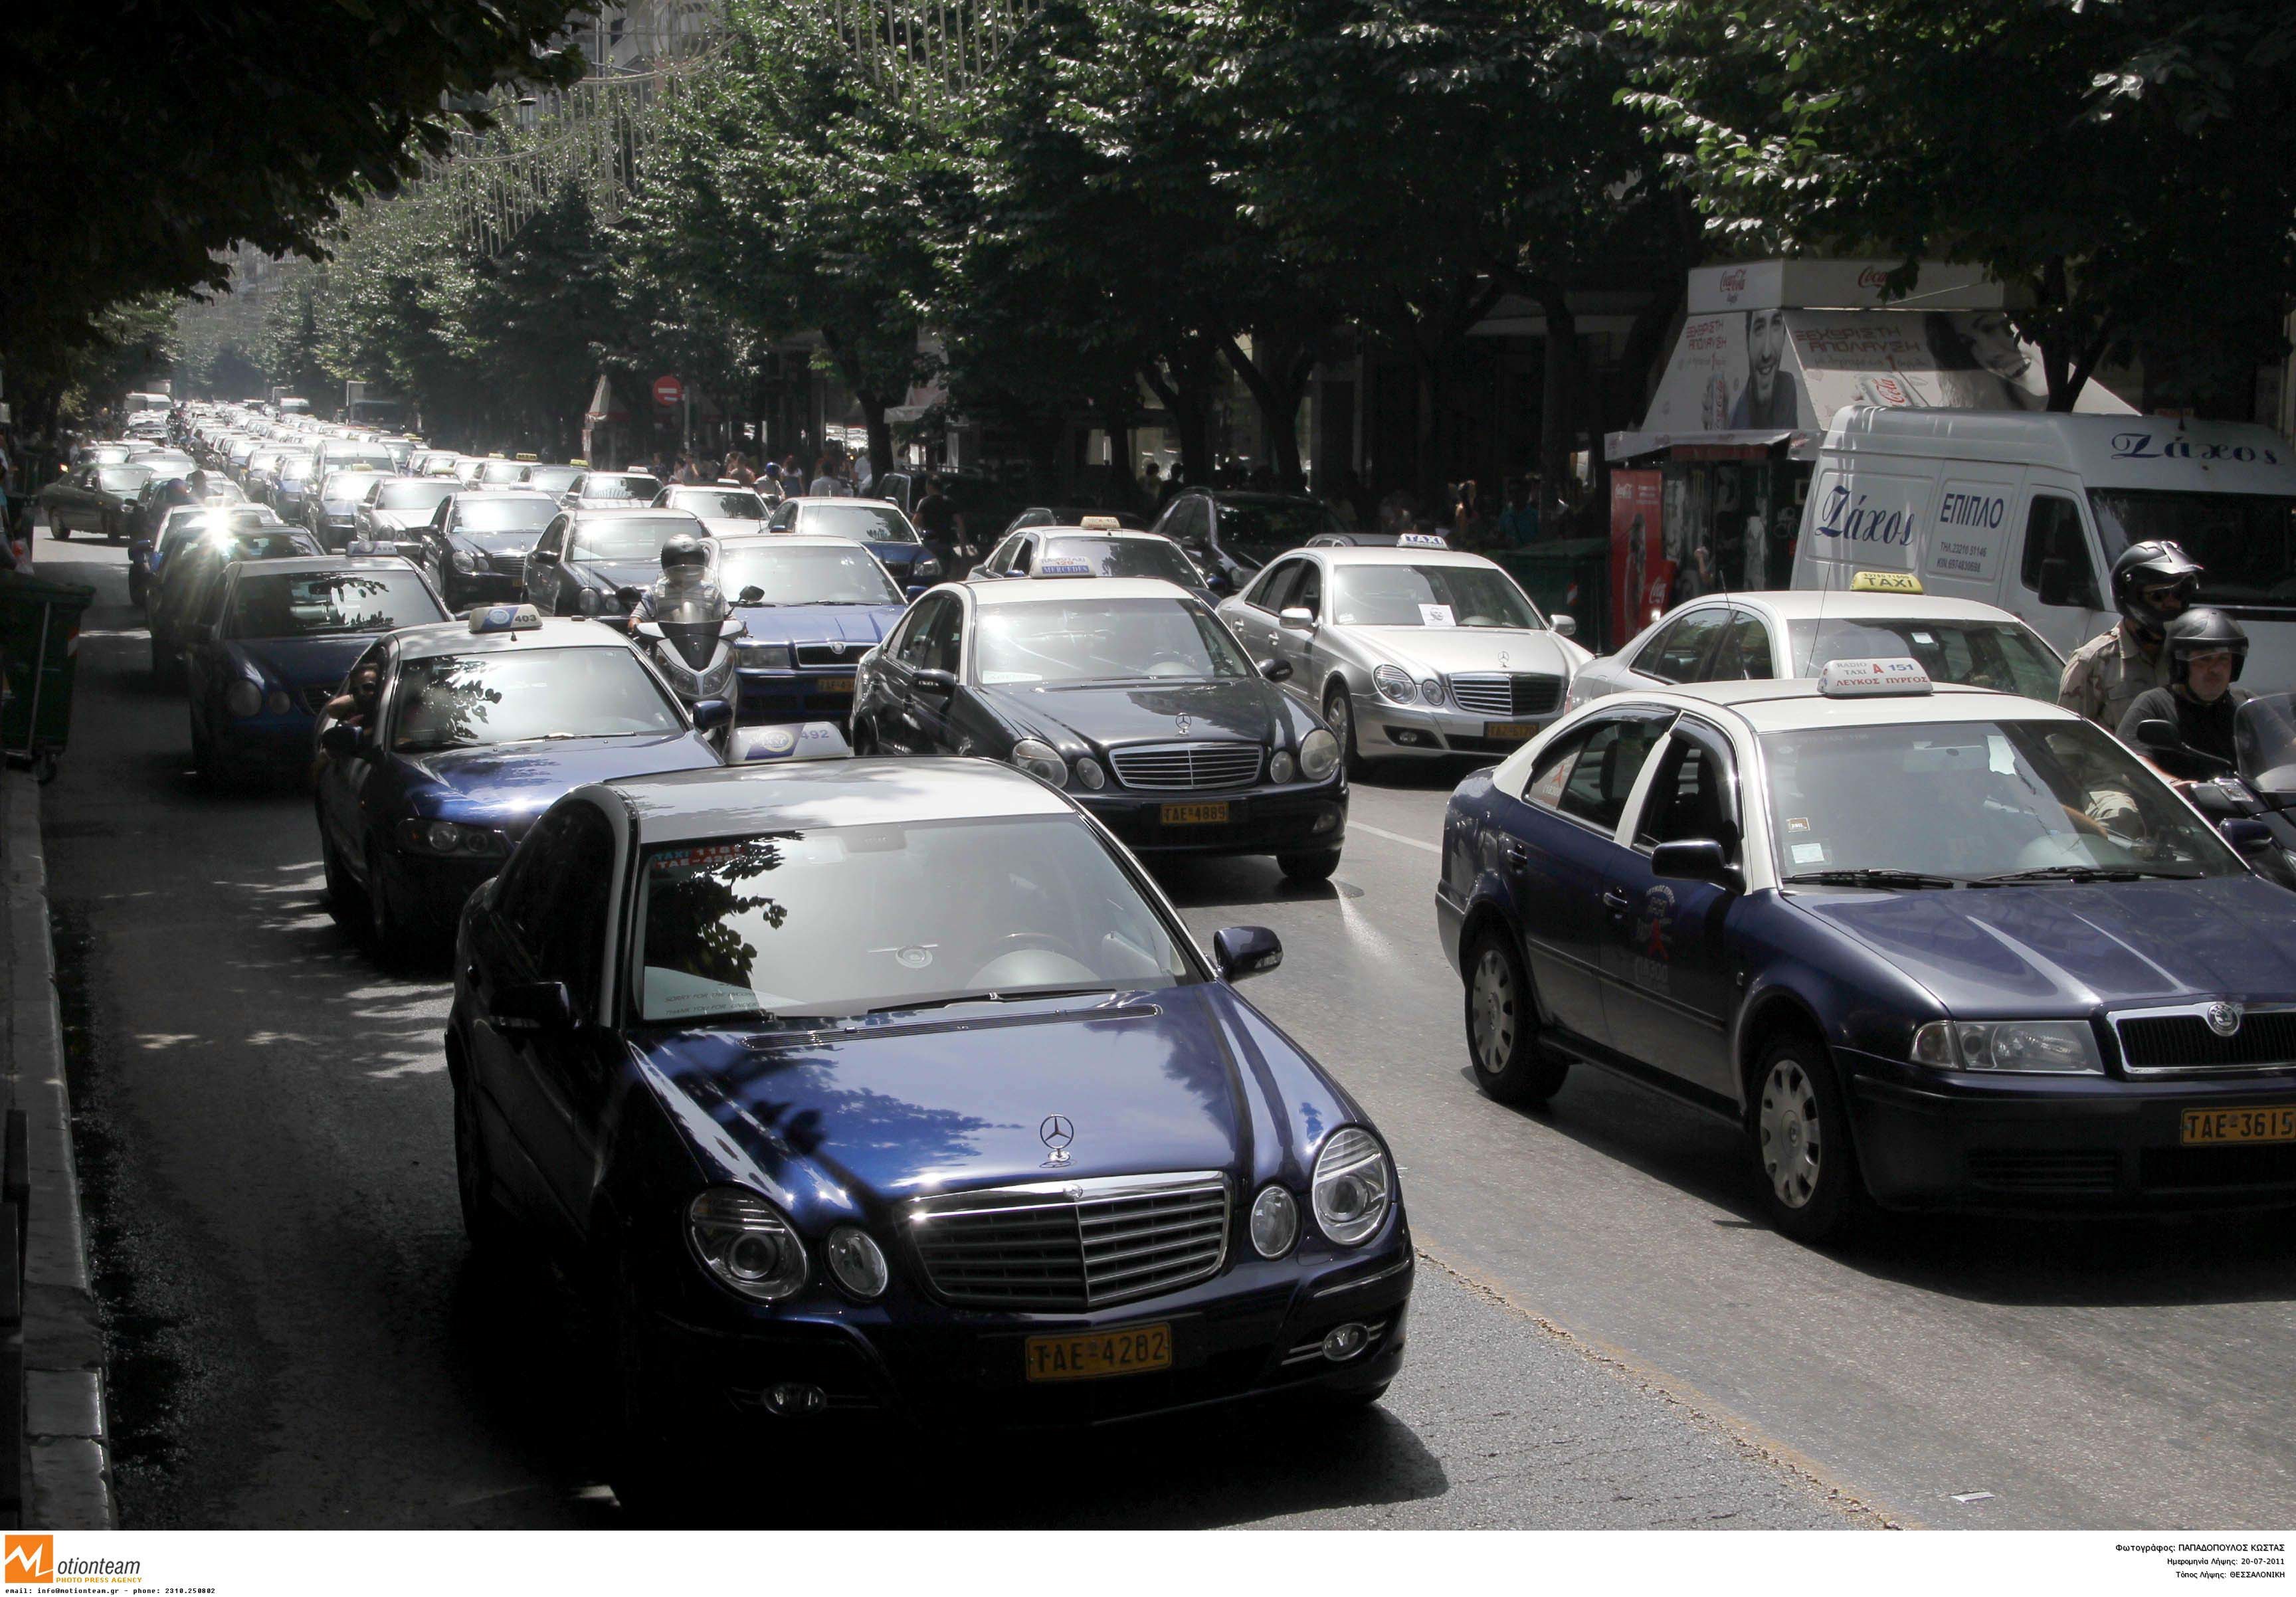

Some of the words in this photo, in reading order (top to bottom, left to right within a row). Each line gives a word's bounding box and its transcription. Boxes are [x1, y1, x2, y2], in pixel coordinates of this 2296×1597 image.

[1939, 493, 2004, 529] ΕΠΙΠΛΟ
[1405, 534, 1443, 544] TAXI
[1864, 577, 1913, 588] TAXI
[801, 729, 830, 739] 492
[2188, 1111, 2294, 1138] TAE-3615
